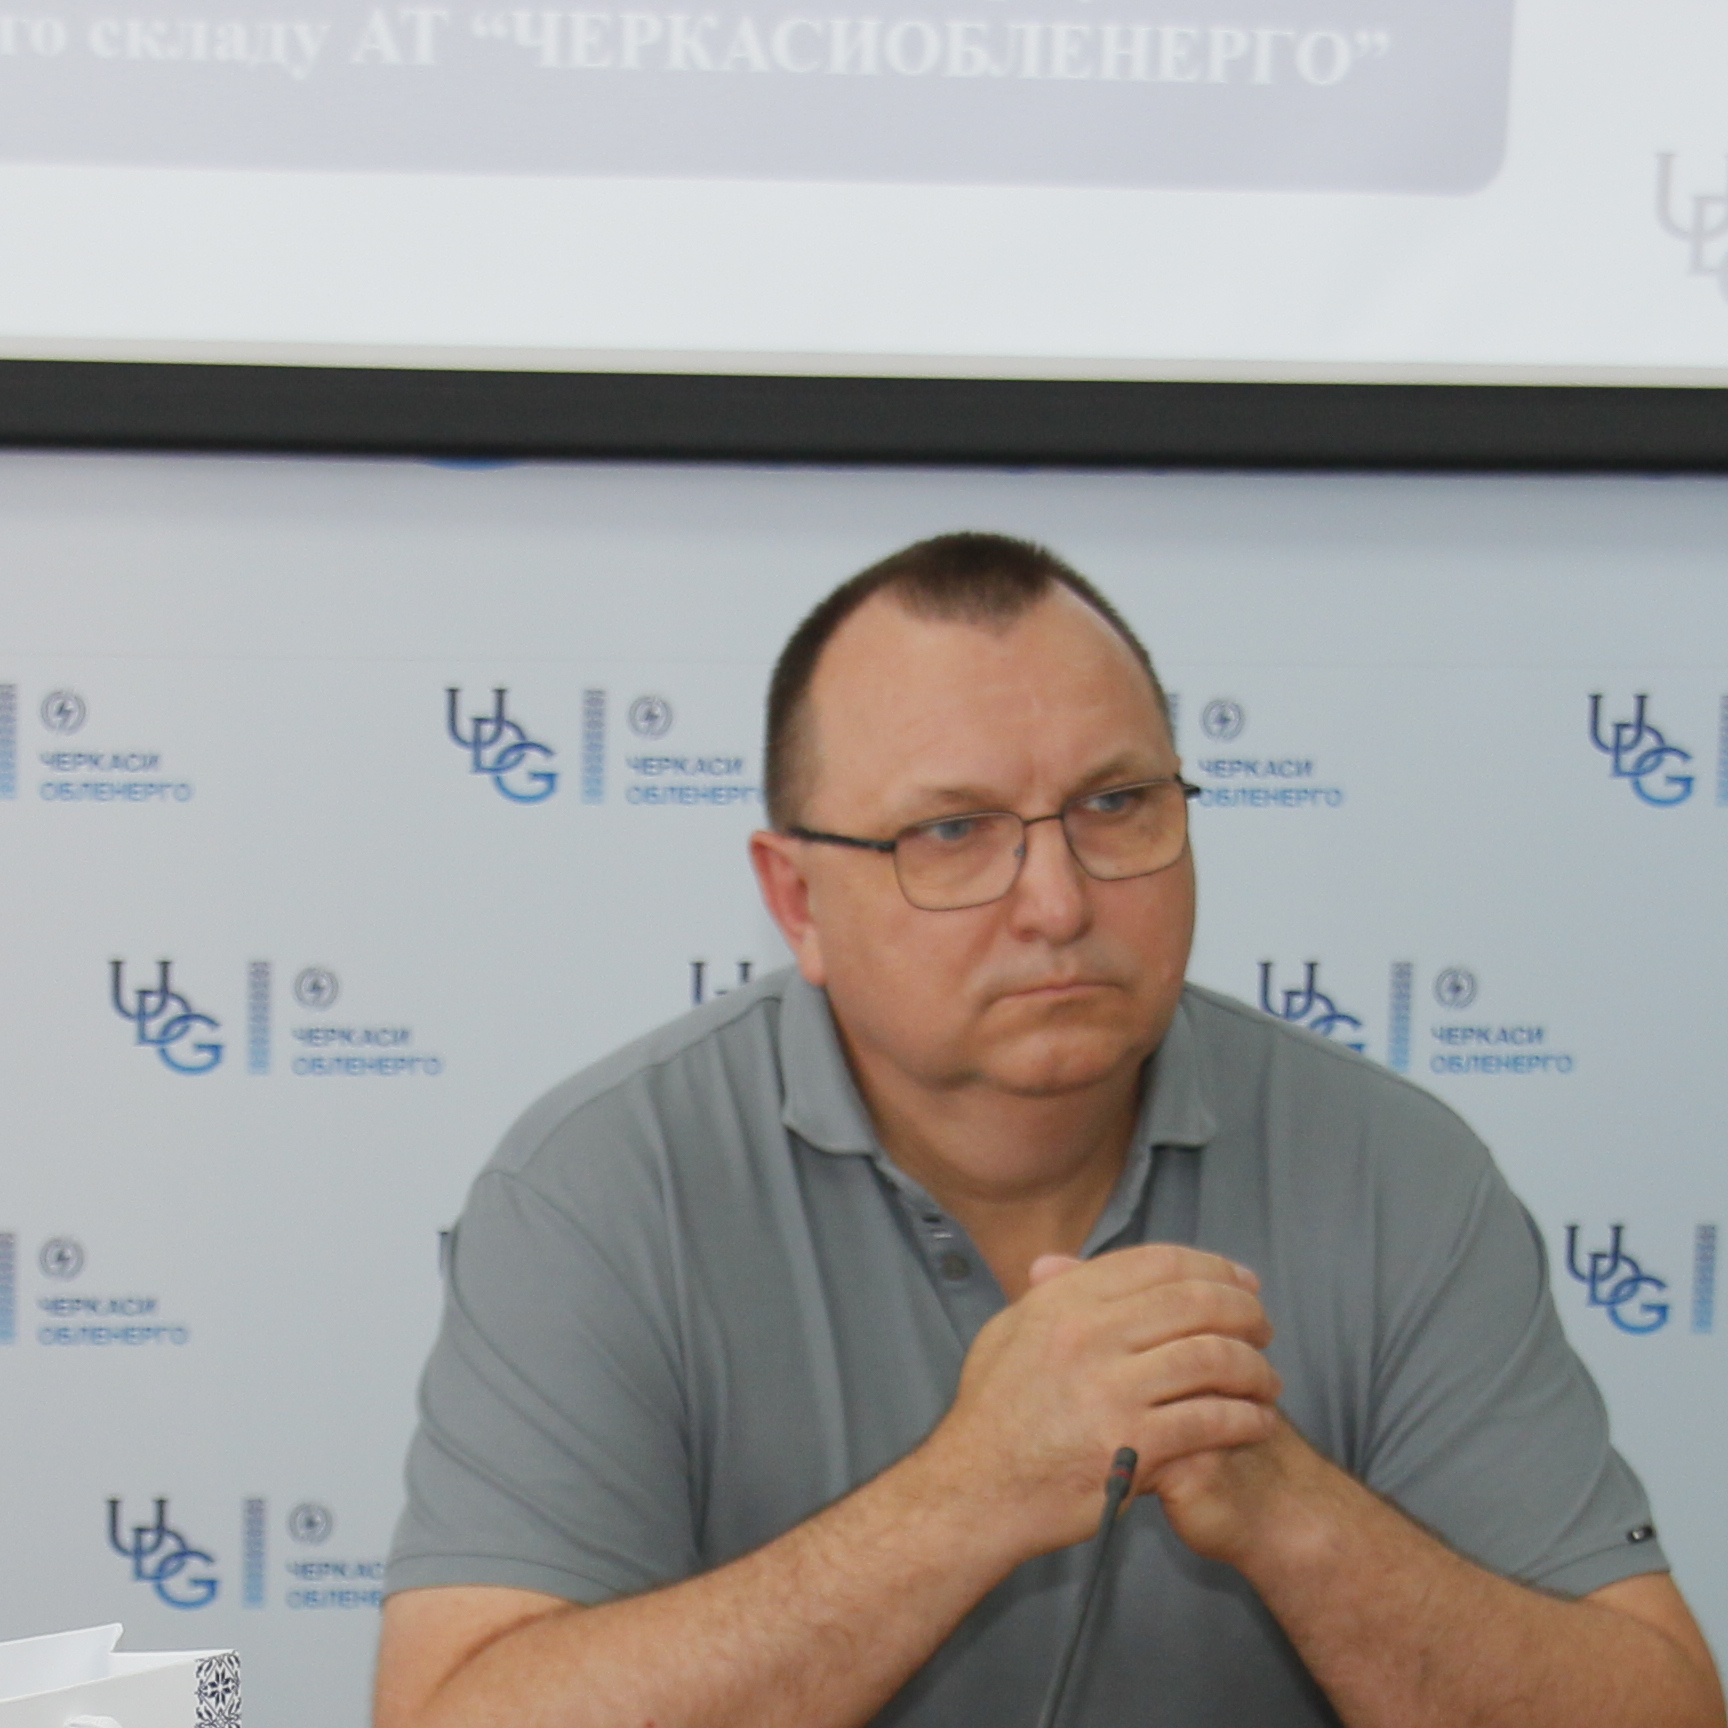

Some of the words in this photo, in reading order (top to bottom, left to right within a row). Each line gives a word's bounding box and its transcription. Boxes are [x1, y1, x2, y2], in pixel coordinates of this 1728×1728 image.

[92, 14, 329, 79] складу
[352, 10, 449, 66] АТ
[40, 751, 161, 772] ЧЕРКАСИ
[627, 756, 744, 777] ЧЕРКАСИ
[1199, 759, 1314, 778] ЧЕРКАСИ
[40, 781, 192, 802] ОБЛЕНЕРГО
[627, 785, 761, 806] ОБЛЕНЕРГ
[1199, 786, 1344, 807] ОБЛЕНЕРГО
[293, 1027, 412, 1047] ЧЕРКАСИ
[1432, 1026, 1545, 1045] ЧЕРКАСИ
[293, 1056, 442, 1077] ОБЛЕНЕРГО
[1431, 1054, 1574, 1074] ОБЛЕНЕРГО
[38, 1297, 158, 1317] ЧЕРКАСИ
[38, 1325, 189, 1346] ОБЛЕНЕРГО
[288, 1589, 384, 1611] ОБЛЕНЕ
